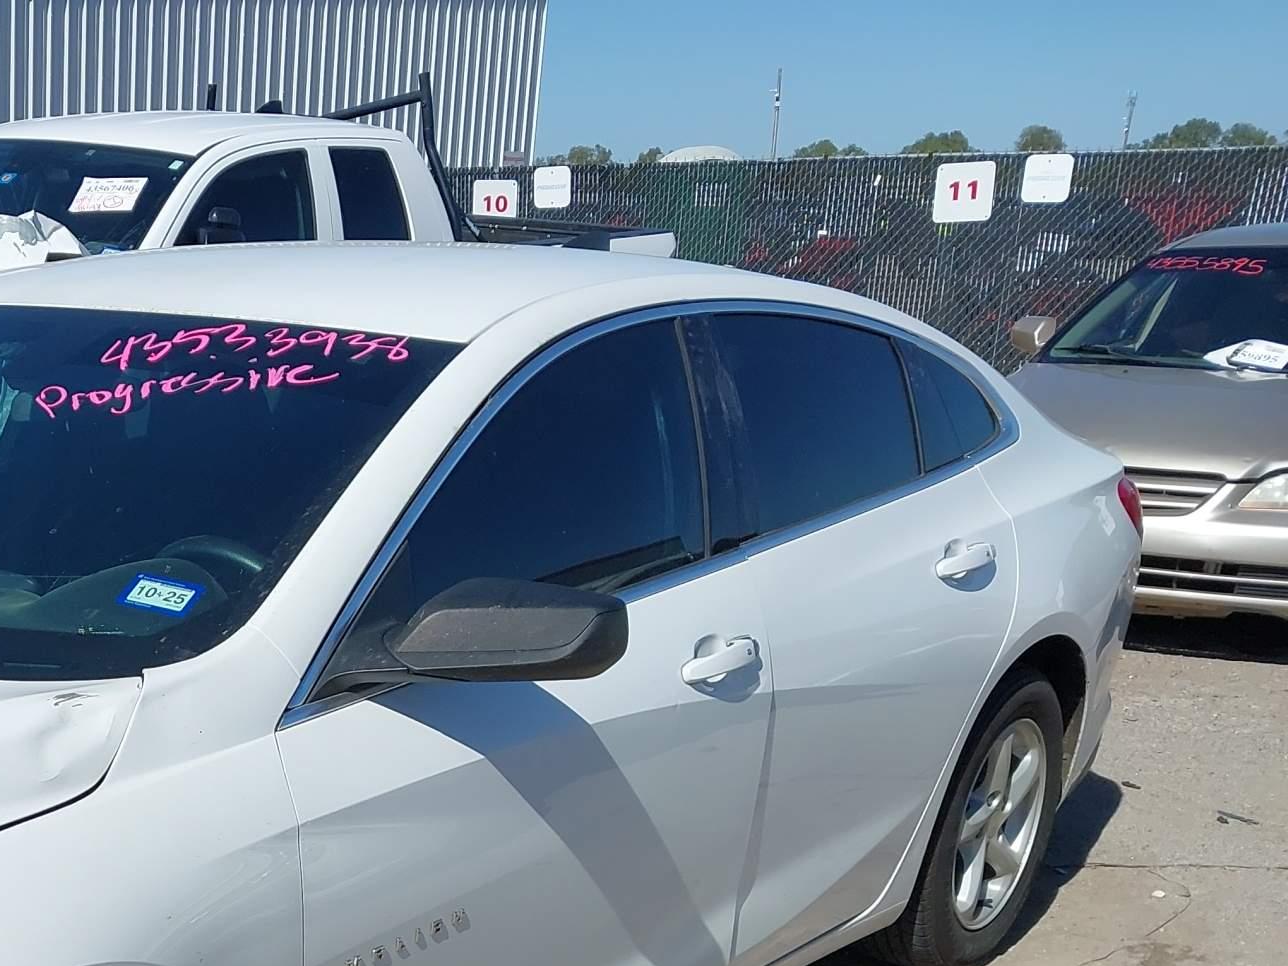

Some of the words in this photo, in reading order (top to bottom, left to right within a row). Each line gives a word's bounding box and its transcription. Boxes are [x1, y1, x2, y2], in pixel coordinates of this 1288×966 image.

[483, 195, 508, 212] 10
[949, 180, 978, 200] 11
[100, 323, 409, 371] 43533938
[35, 358, 339, 418] Progressive
